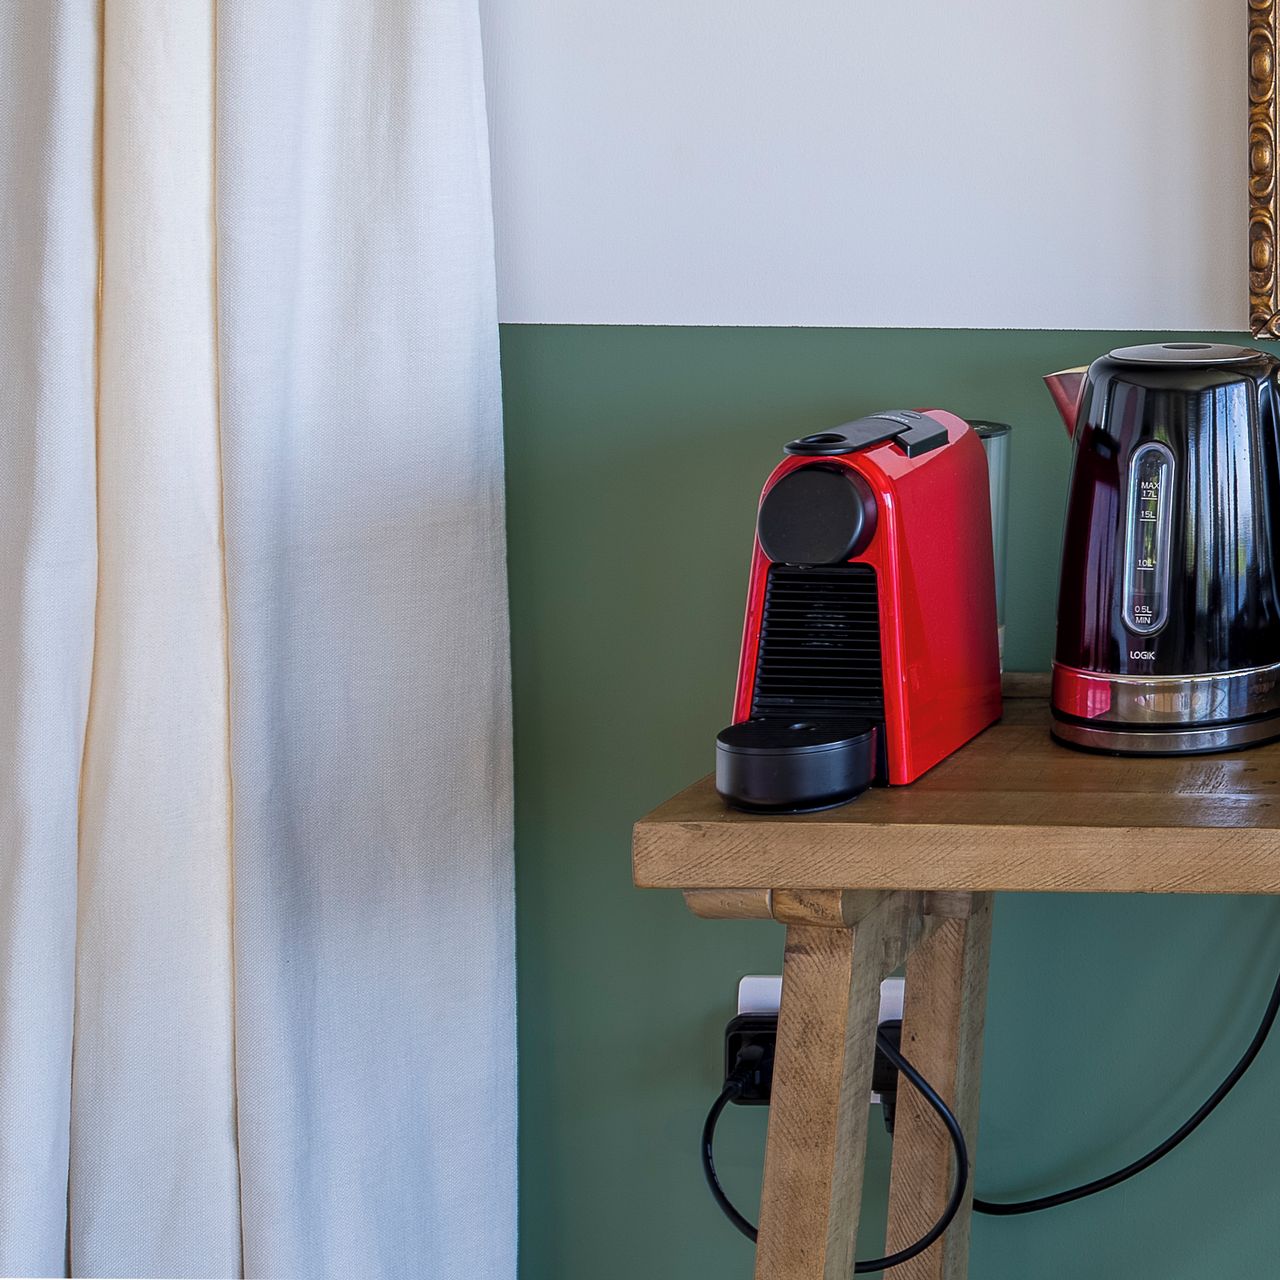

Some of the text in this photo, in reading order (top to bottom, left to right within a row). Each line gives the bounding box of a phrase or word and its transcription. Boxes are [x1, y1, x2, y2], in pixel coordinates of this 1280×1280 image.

[1141, 481, 1160, 489] MAX
[1135, 616, 1151, 624] MIN
[1130, 650, 1156, 660] LOGIK
